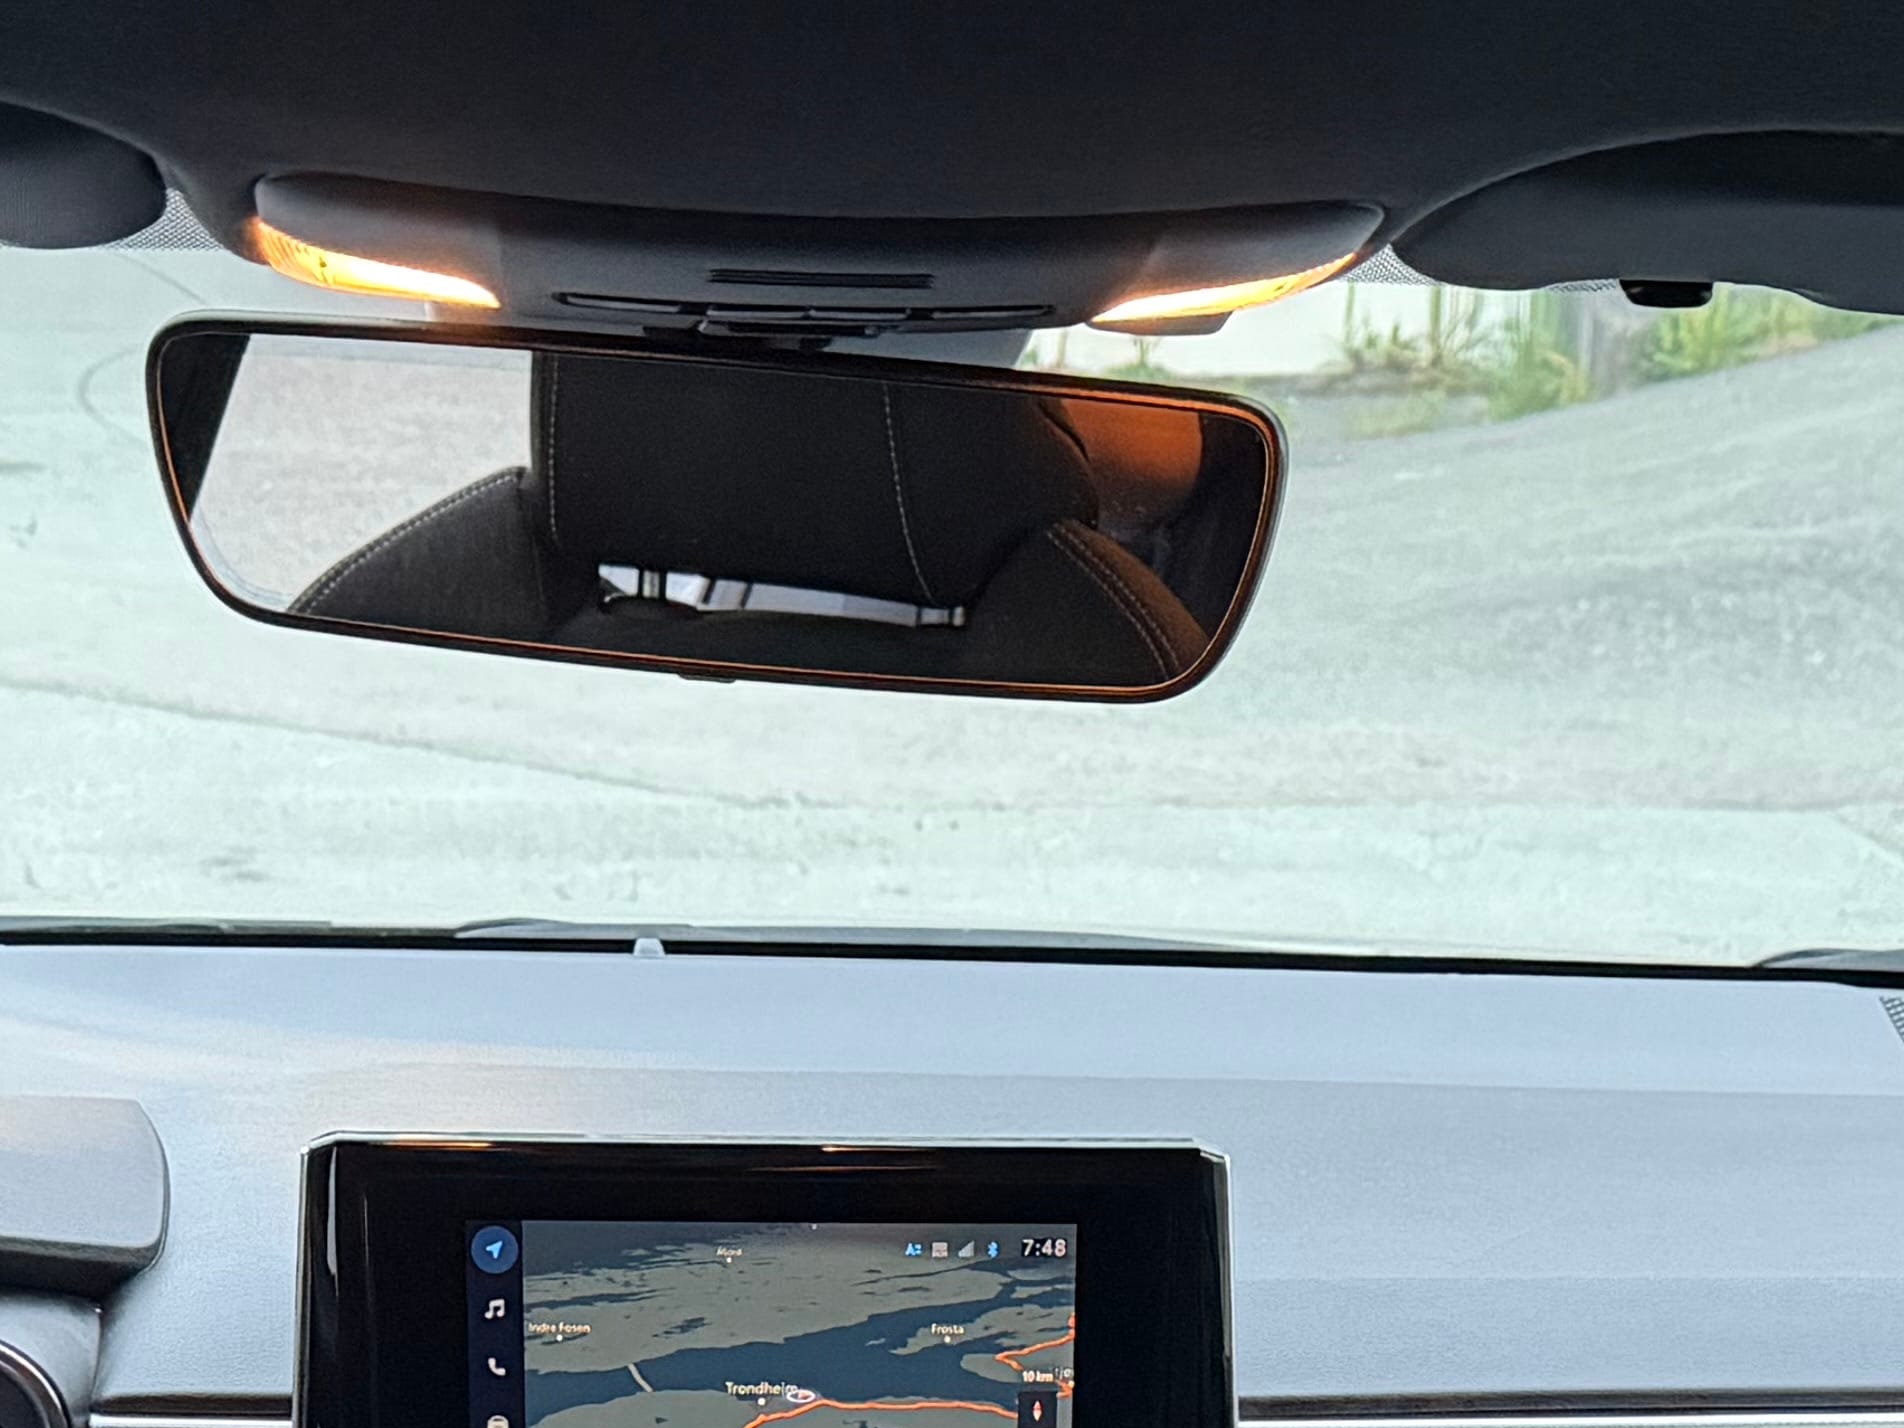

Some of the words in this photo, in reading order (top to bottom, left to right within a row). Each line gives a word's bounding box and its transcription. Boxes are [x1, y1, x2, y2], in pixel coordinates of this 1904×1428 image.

[1021, 1239, 1066, 1257] 7:48
[931, 1323, 964, 1335] Frosta
[1022, 1370, 1036, 1383] 10
[1036, 1370, 1054, 1383] km
[725, 1381, 798, 1395] Trondheim
